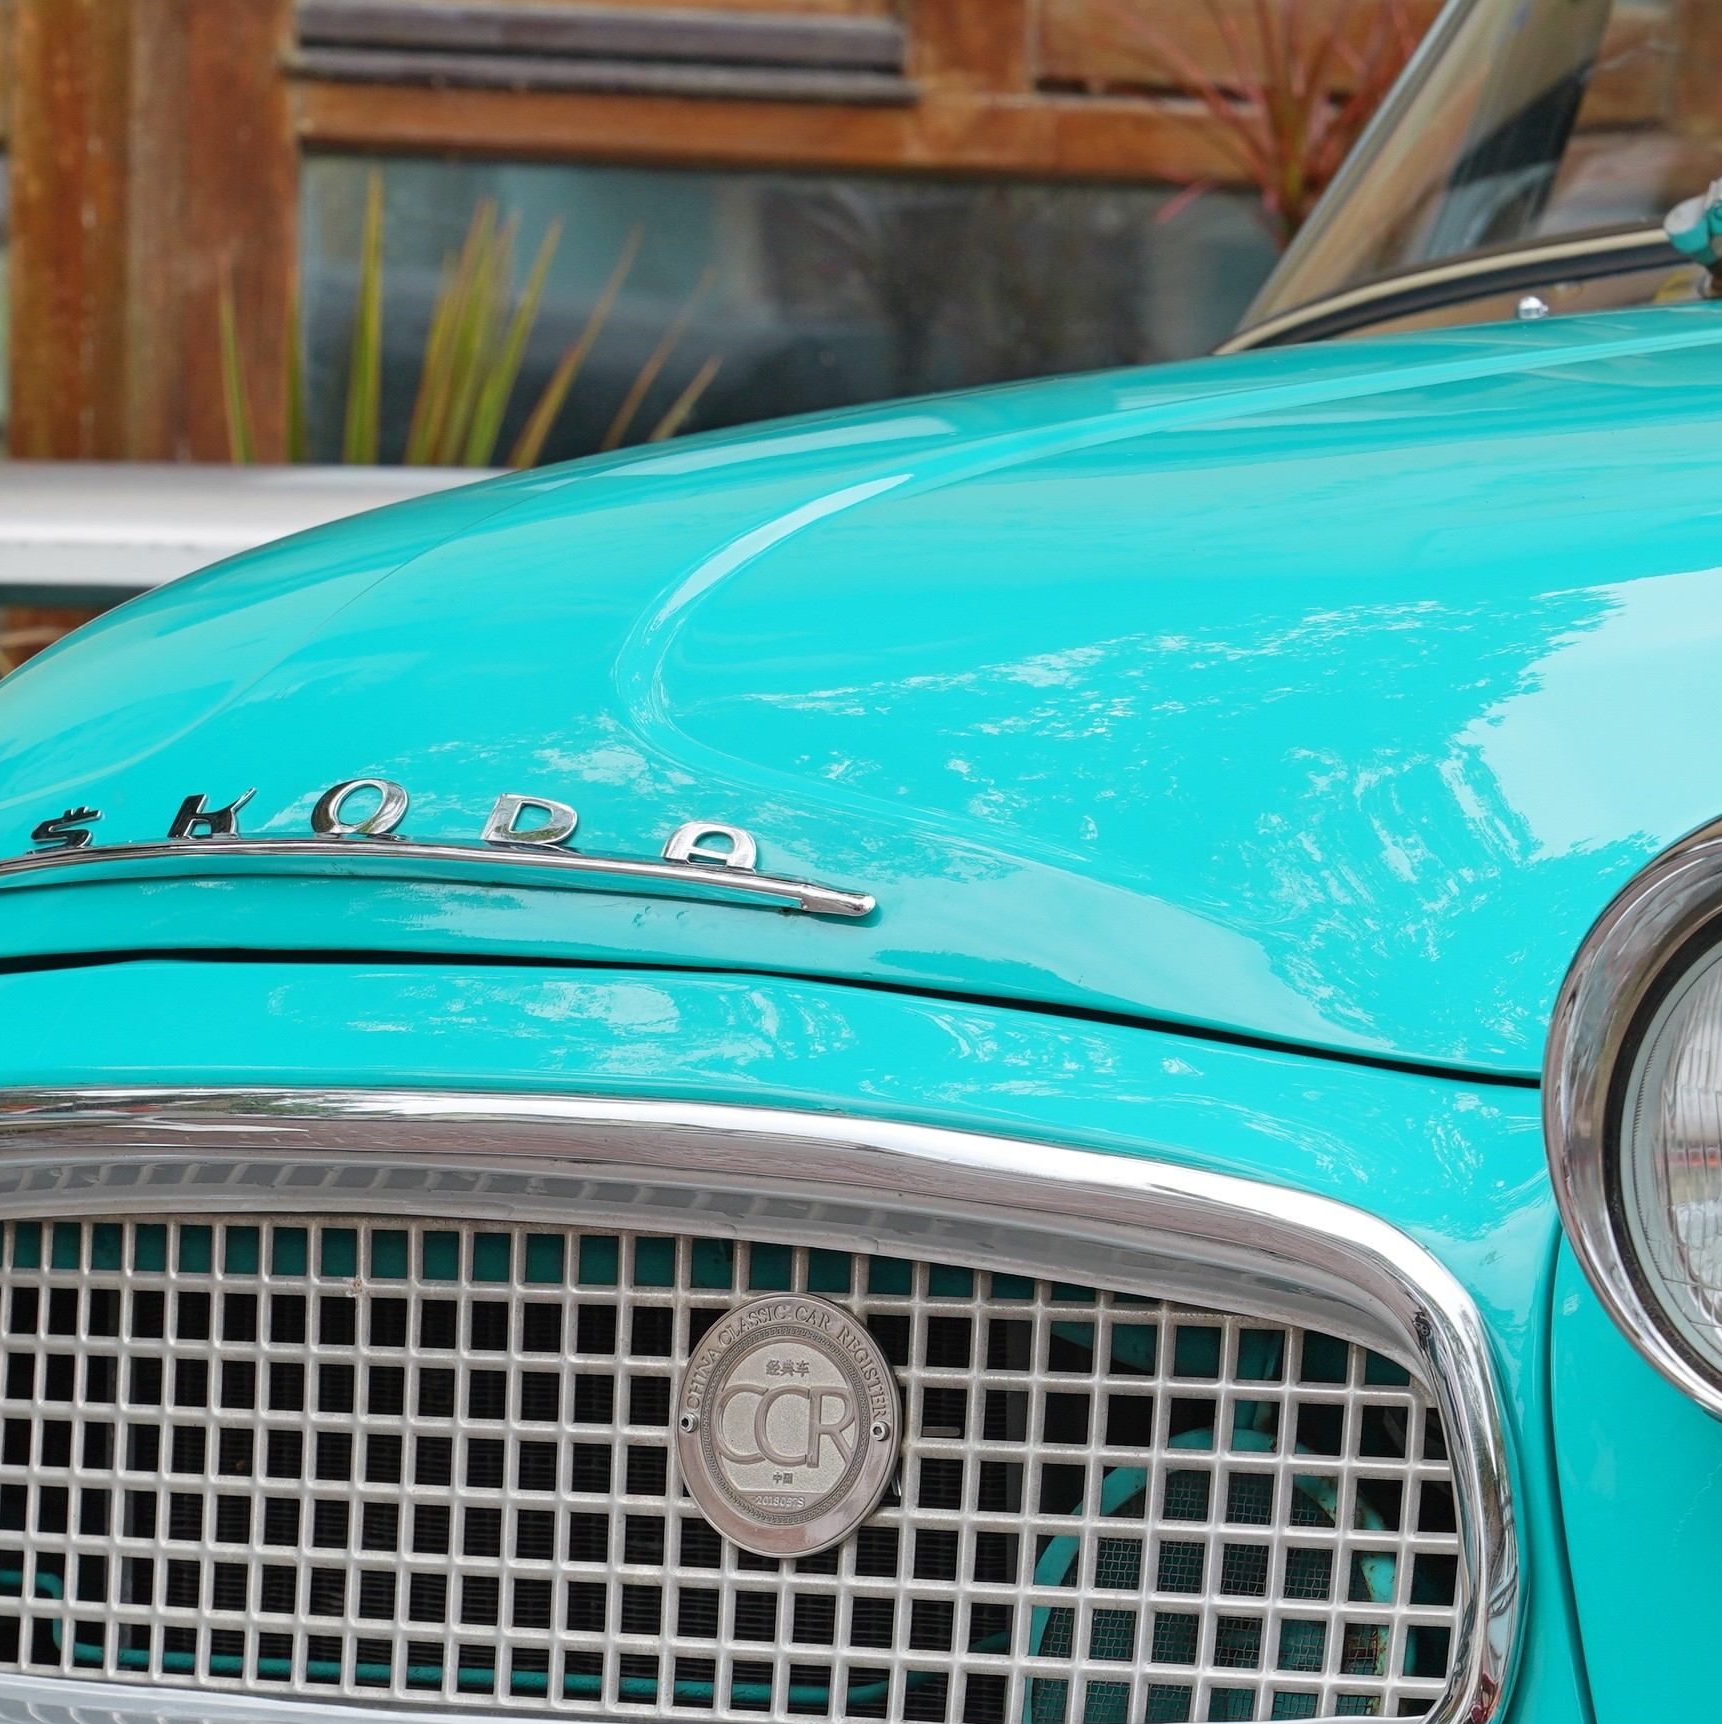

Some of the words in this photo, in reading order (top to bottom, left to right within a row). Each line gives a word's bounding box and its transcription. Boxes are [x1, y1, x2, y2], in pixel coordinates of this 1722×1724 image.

[686, 1348, 723, 1409] CHINA
[718, 1304, 787, 1346] CLASSIC
[795, 1305, 831, 1332] CAR
[836, 1326, 888, 1420] REGISTER
[765, 1359, 810, 1378] 经典车
[711, 1383, 856, 1469] CCR
[772, 1471, 793, 1485] 中国
